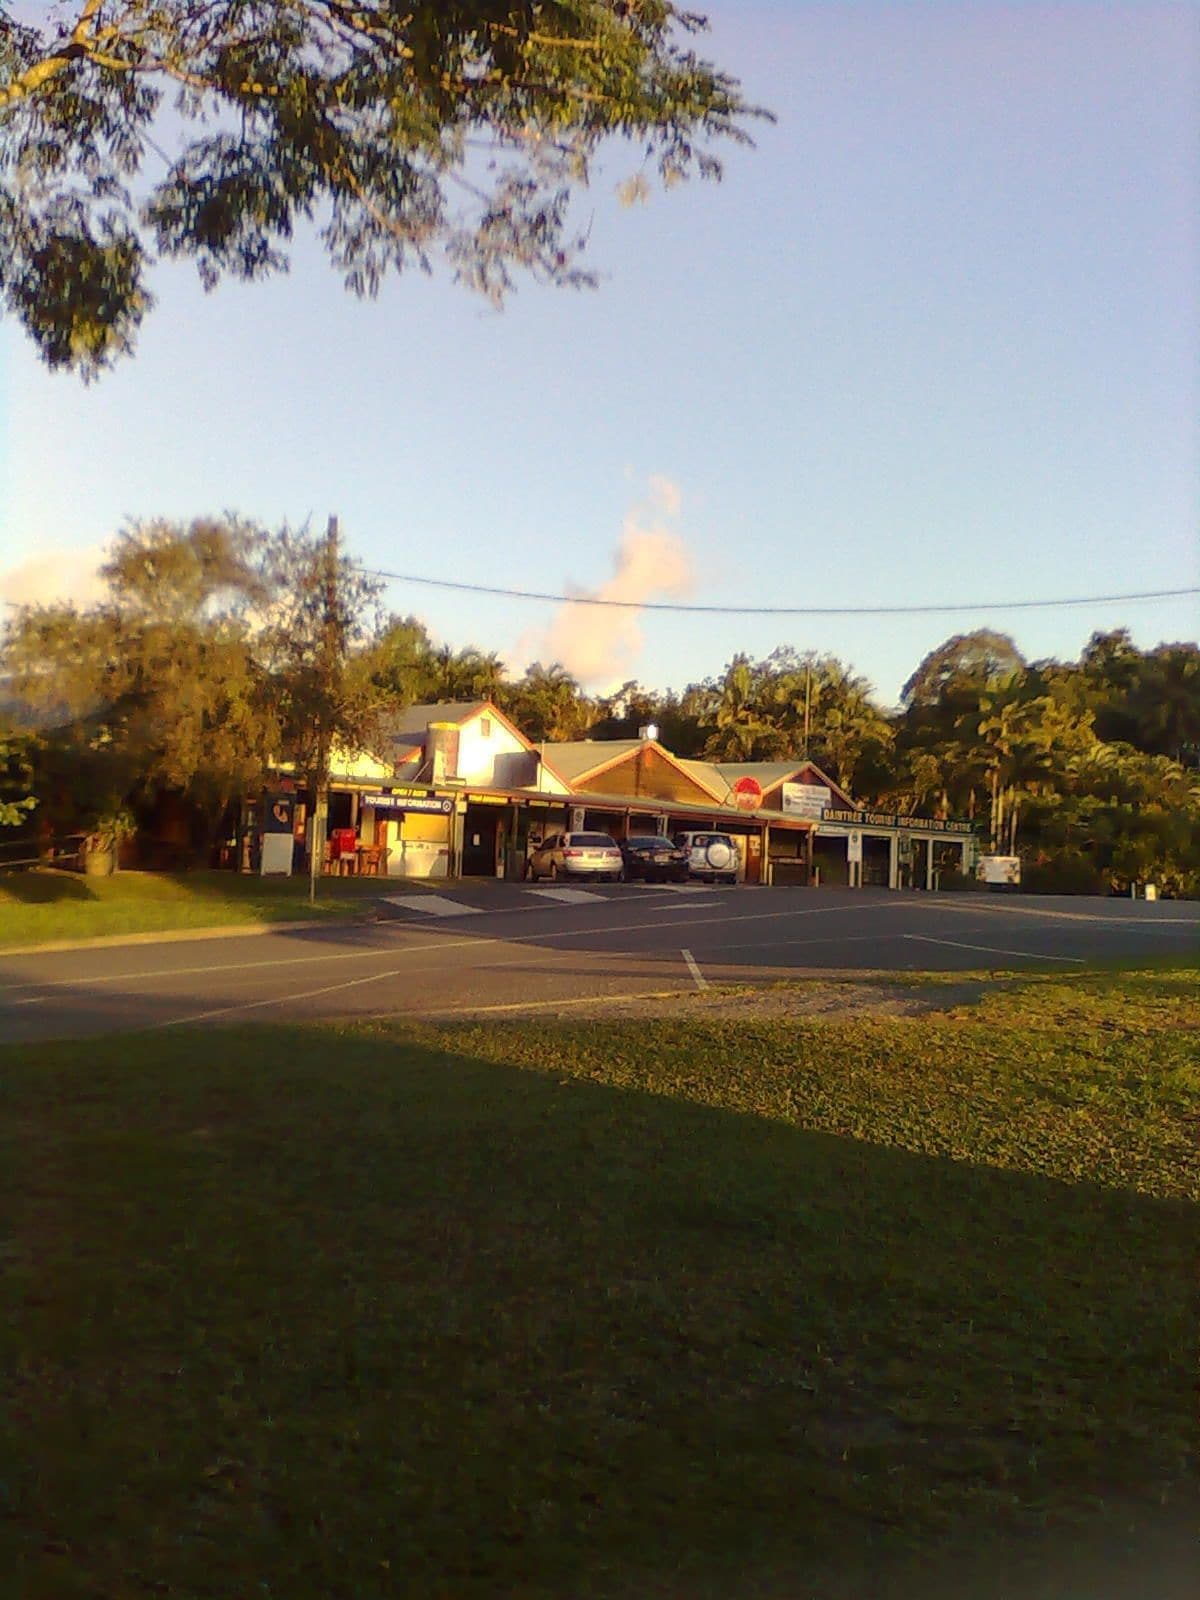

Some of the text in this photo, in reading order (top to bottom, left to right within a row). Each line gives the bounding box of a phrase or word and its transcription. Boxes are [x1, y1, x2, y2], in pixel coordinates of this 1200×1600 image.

[865, 813, 895, 826] TOURIST
[898, 817, 944, 831] INFORMATION
[946, 821, 971, 833] CENTRE
